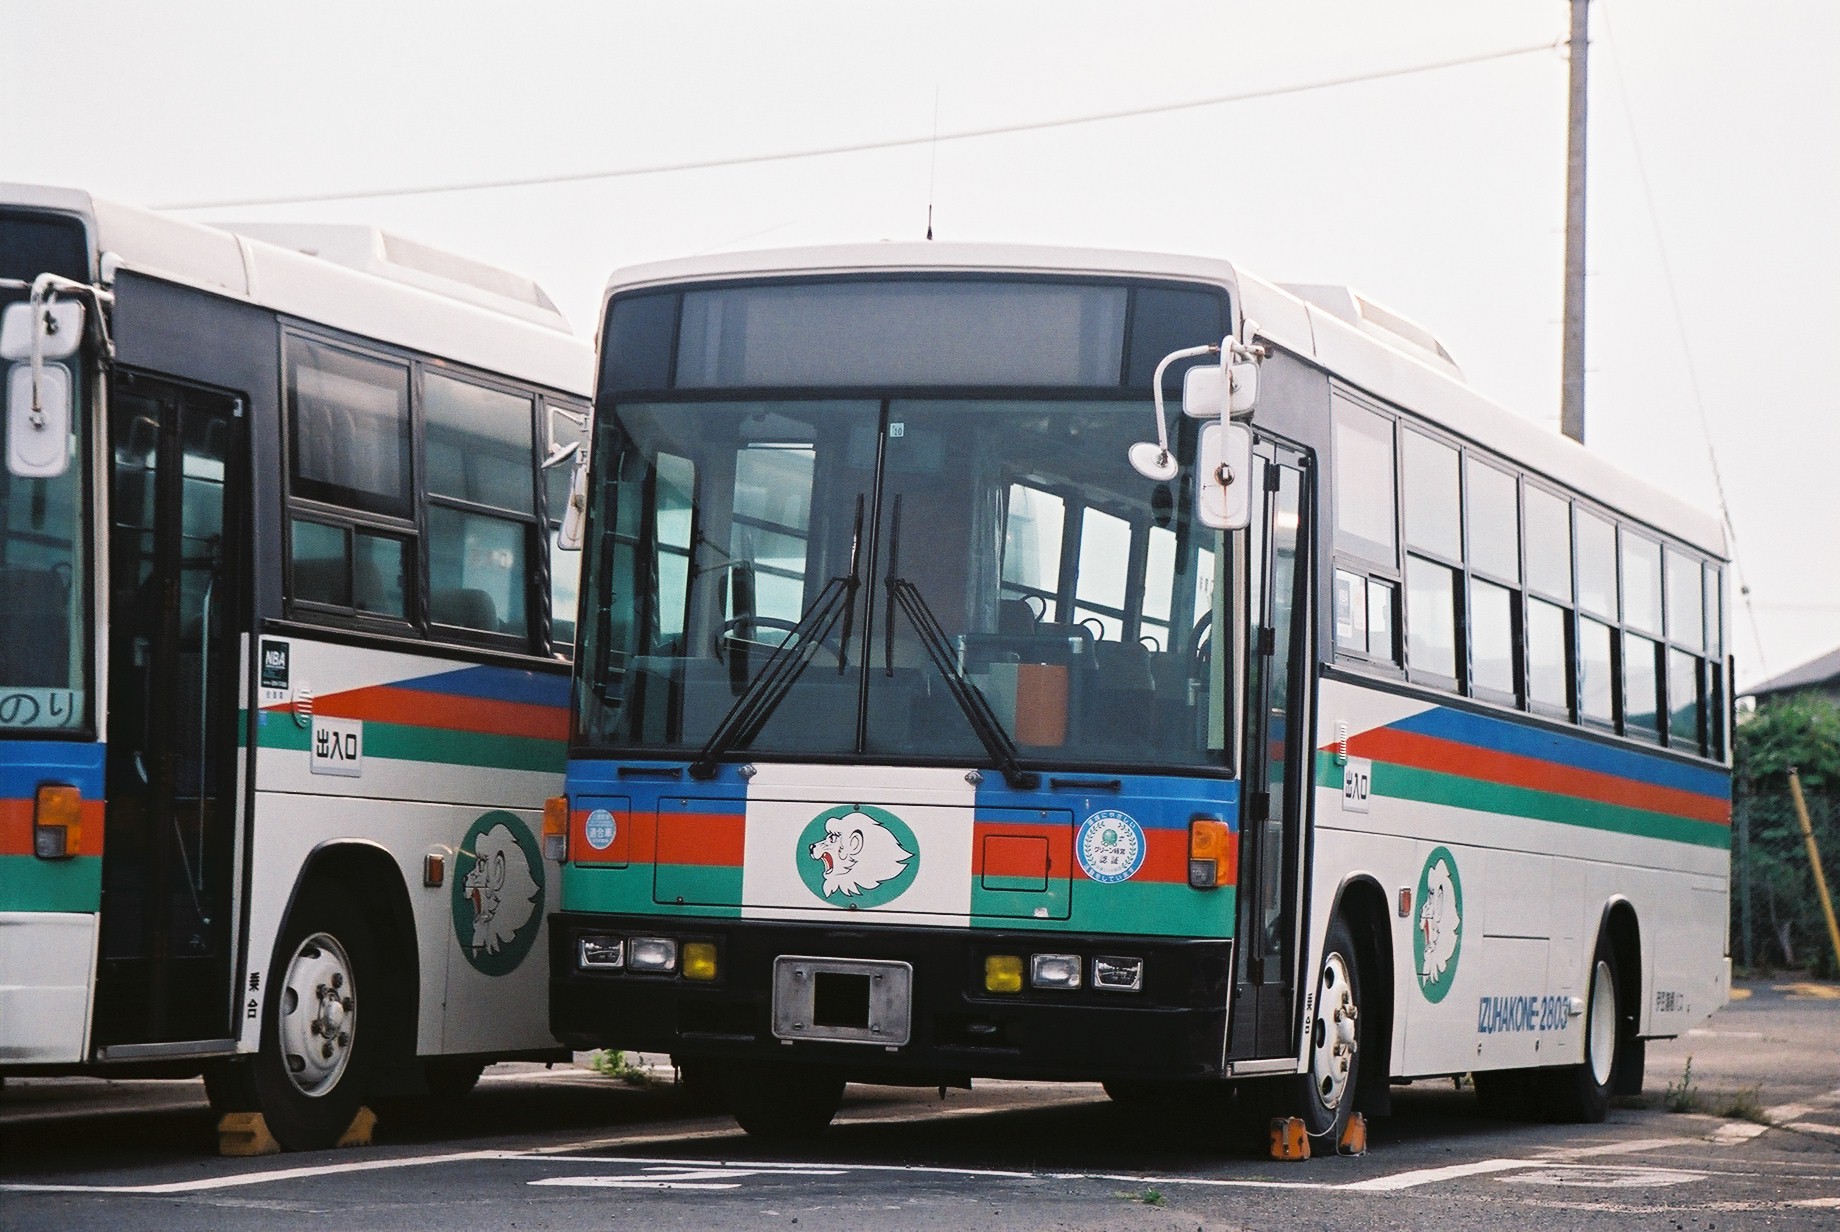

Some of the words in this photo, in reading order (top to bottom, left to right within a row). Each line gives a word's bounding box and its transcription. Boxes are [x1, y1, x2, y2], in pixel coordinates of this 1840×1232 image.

[265, 650, 286, 667] NBA
[316, 728, 358, 761] 出入口
[1345, 770, 1368, 801] 出入口
[248, 972, 261, 1019] 乗合
